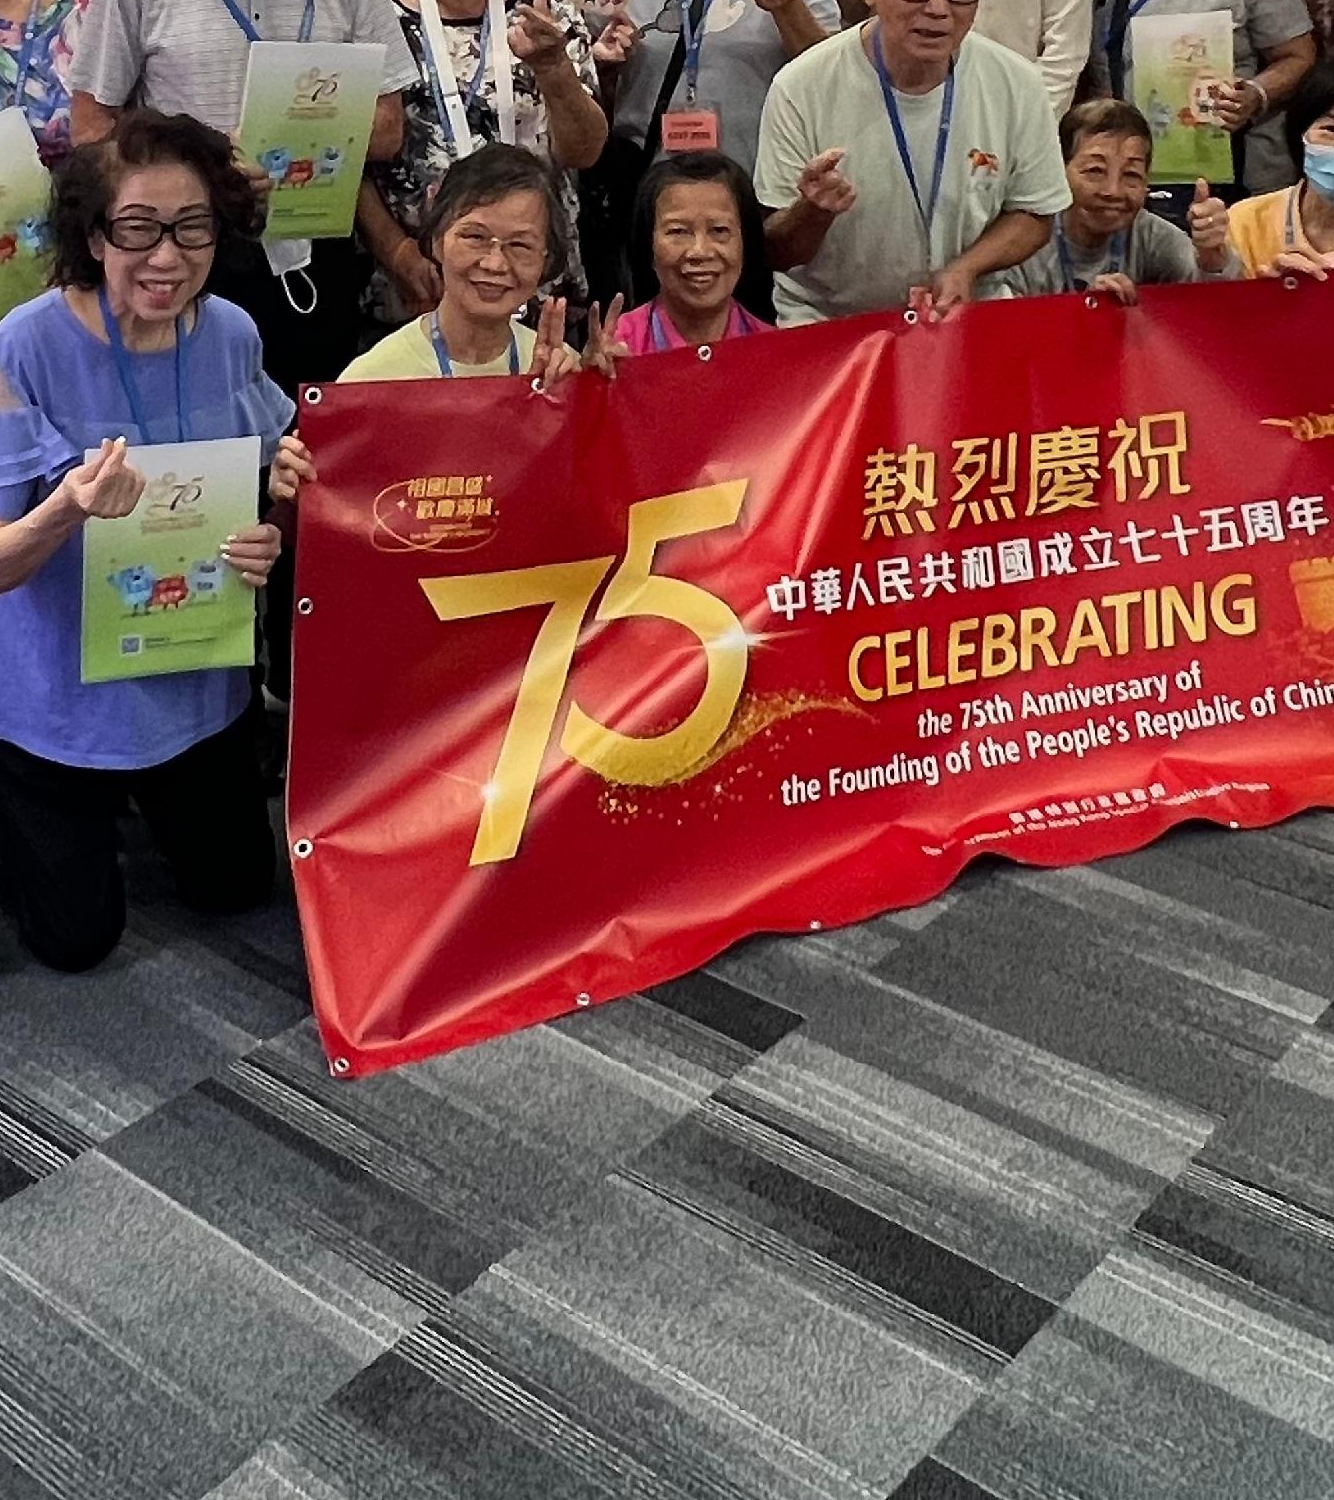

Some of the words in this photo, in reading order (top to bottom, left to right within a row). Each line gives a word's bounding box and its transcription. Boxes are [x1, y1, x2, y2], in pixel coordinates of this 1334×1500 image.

[861, 410, 1191, 540] 熱烈慶祝
[765, 494, 1330, 622] 中華人民共和國成立七十五周年
[418, 477, 749, 866] 75
[848, 573, 1258, 703] CELEBRATING
[917, 710, 953, 740] the
[960, 696, 1015, 731] 75th
[1020, 673, 1169, 720] Anniversary
[1175, 660, 1203, 693] of
[780, 773, 822, 807] the
[828, 748, 940, 796] Founding
[945, 740, 971, 775] of
[979, 733, 1021, 770] the
[1027, 715, 1132, 760] People's
[1136, 699, 1246, 747] Republic
[1250, 690, 1277, 720] of
